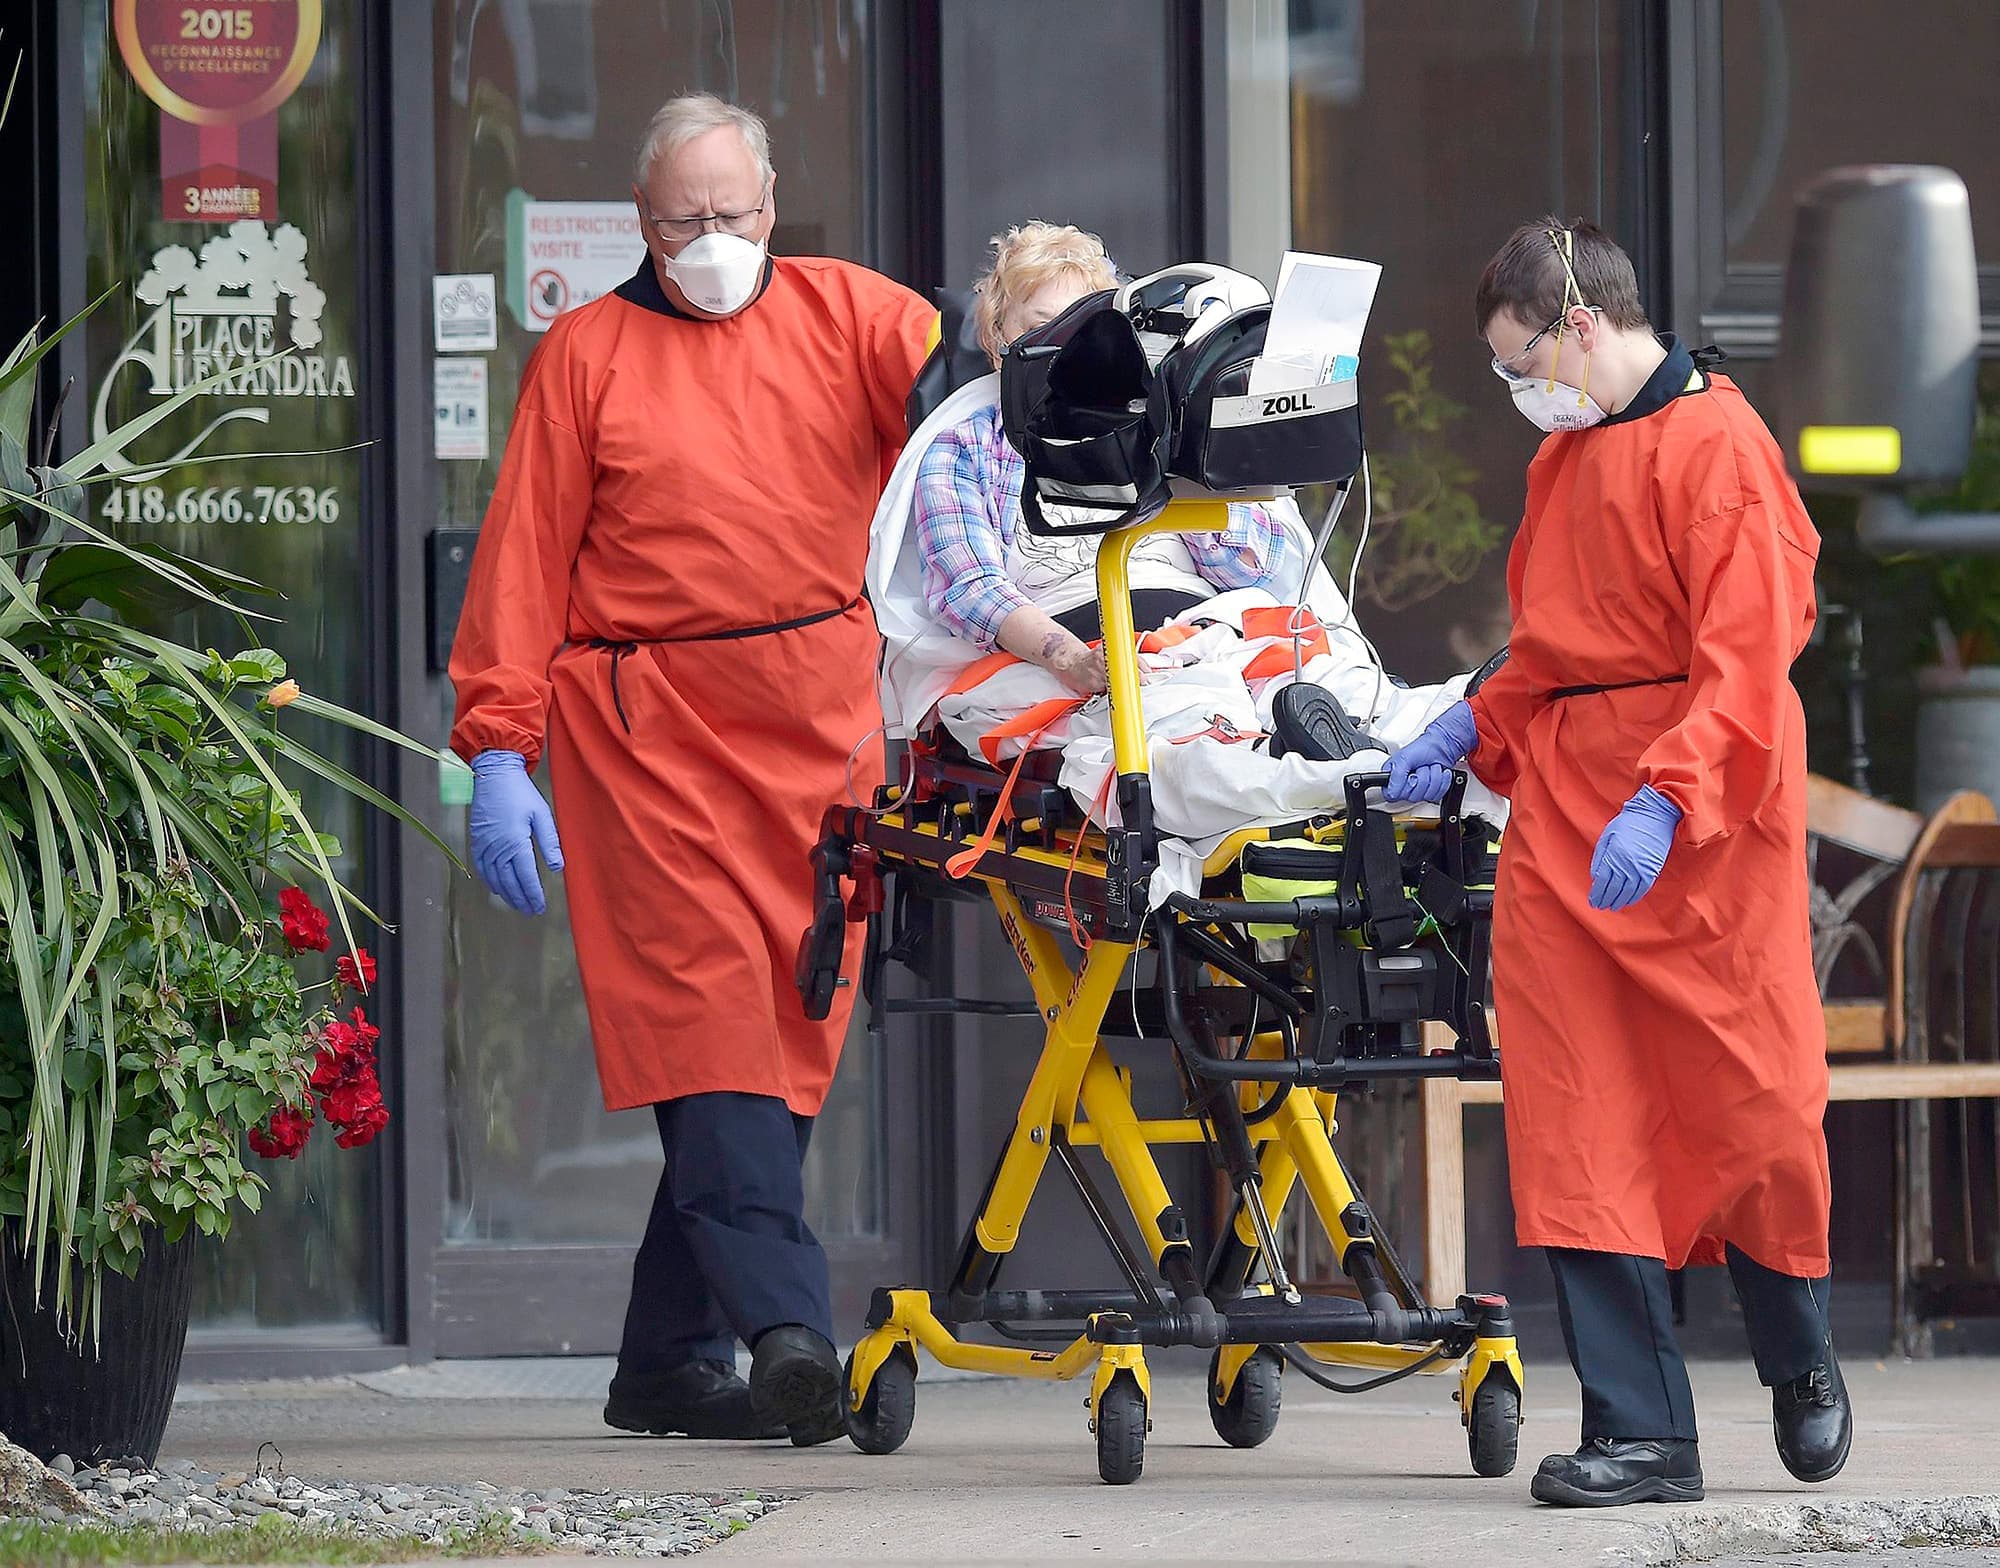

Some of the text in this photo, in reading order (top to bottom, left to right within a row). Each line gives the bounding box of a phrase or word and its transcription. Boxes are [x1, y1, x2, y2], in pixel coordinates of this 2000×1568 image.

[180, 9, 254, 39] 2015
[151, 45, 282, 58] RECONNAISSANCE
[184, 187, 200, 214] 3
[530, 240, 583, 258] VISITE
[174, 316, 275, 356] PLACE
[101, 486, 340, 524] 418.666.7636
